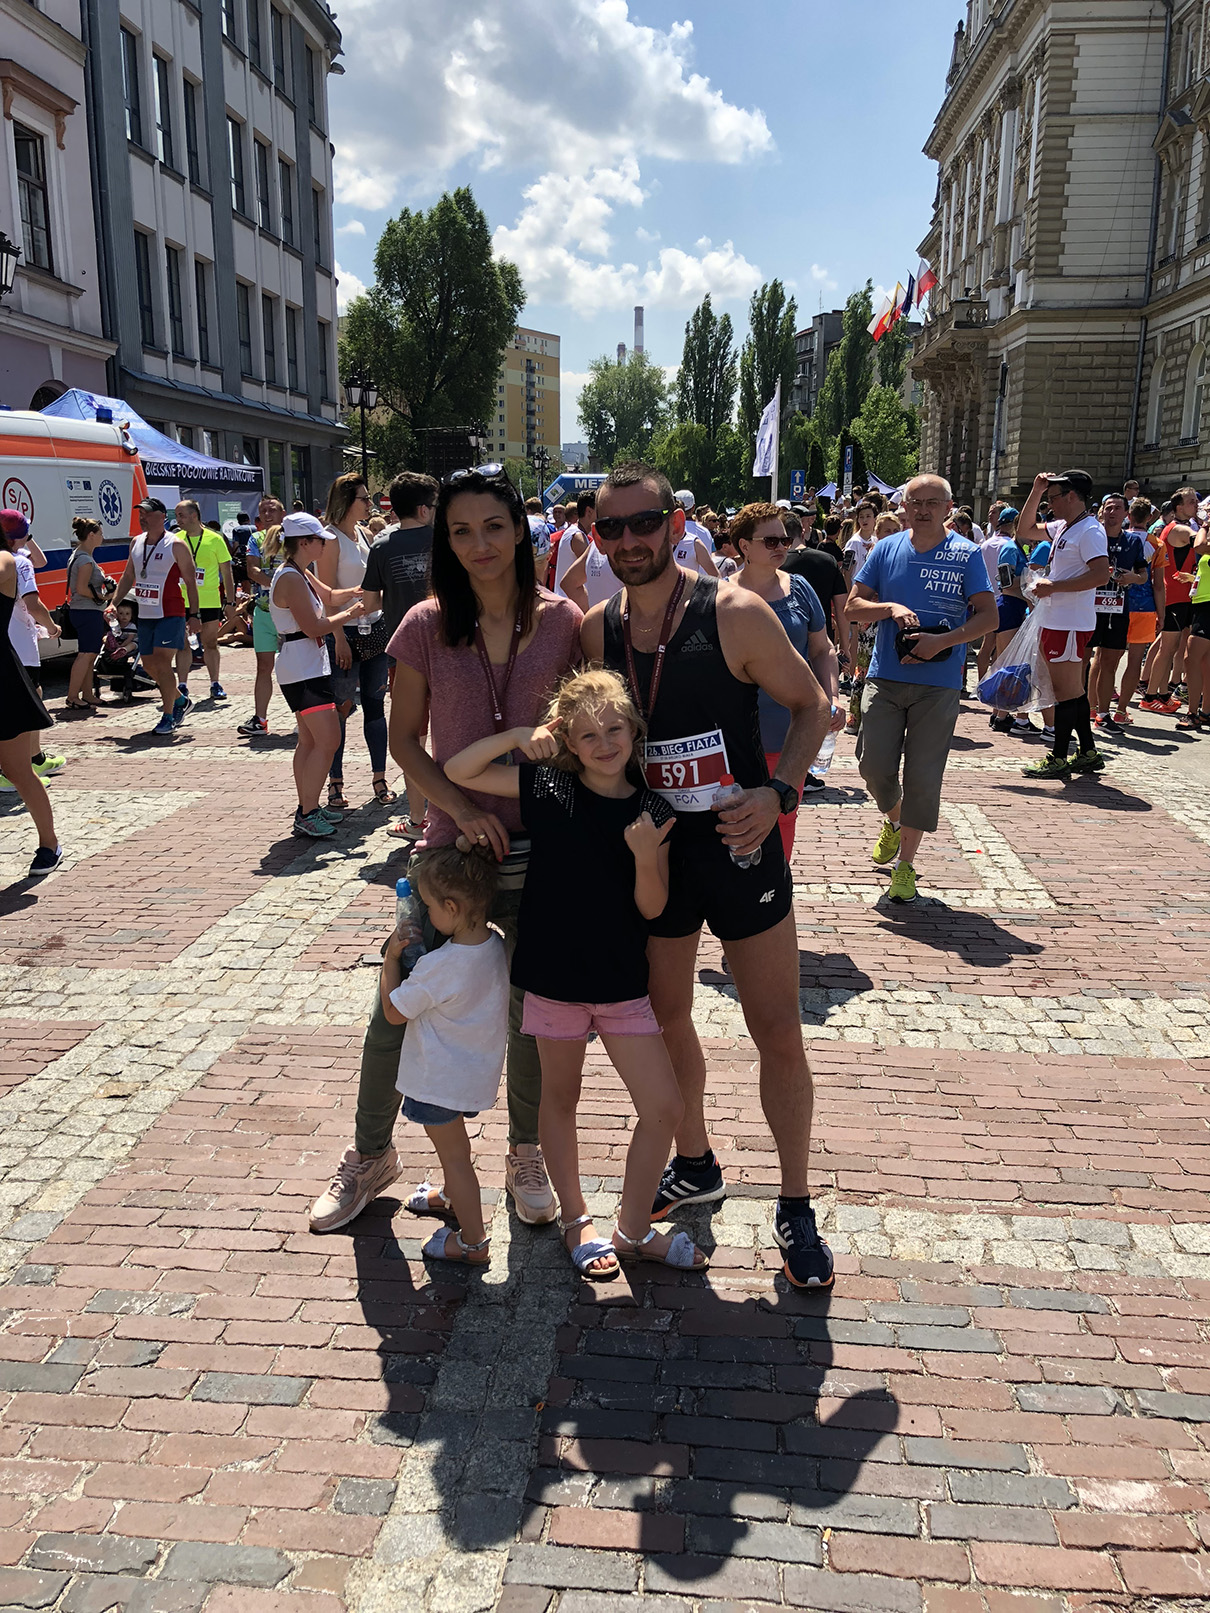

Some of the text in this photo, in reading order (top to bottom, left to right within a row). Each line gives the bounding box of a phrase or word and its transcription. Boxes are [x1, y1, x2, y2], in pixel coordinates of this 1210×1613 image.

[145, 462, 256, 483] BIELSKIE POGOTOWIE RATUNKOWE
[574, 478, 603, 489] ME
[944, 541, 981, 553] URBA
[1101, 597, 1118, 606] 696
[681, 643, 714, 653] adidas
[660, 743, 684, 756] BIEG
[686, 736, 718, 752] FIATA
[661, 760, 700, 788] 591
[674, 794, 700, 805] FCA
[759, 889, 776, 903] 4F
